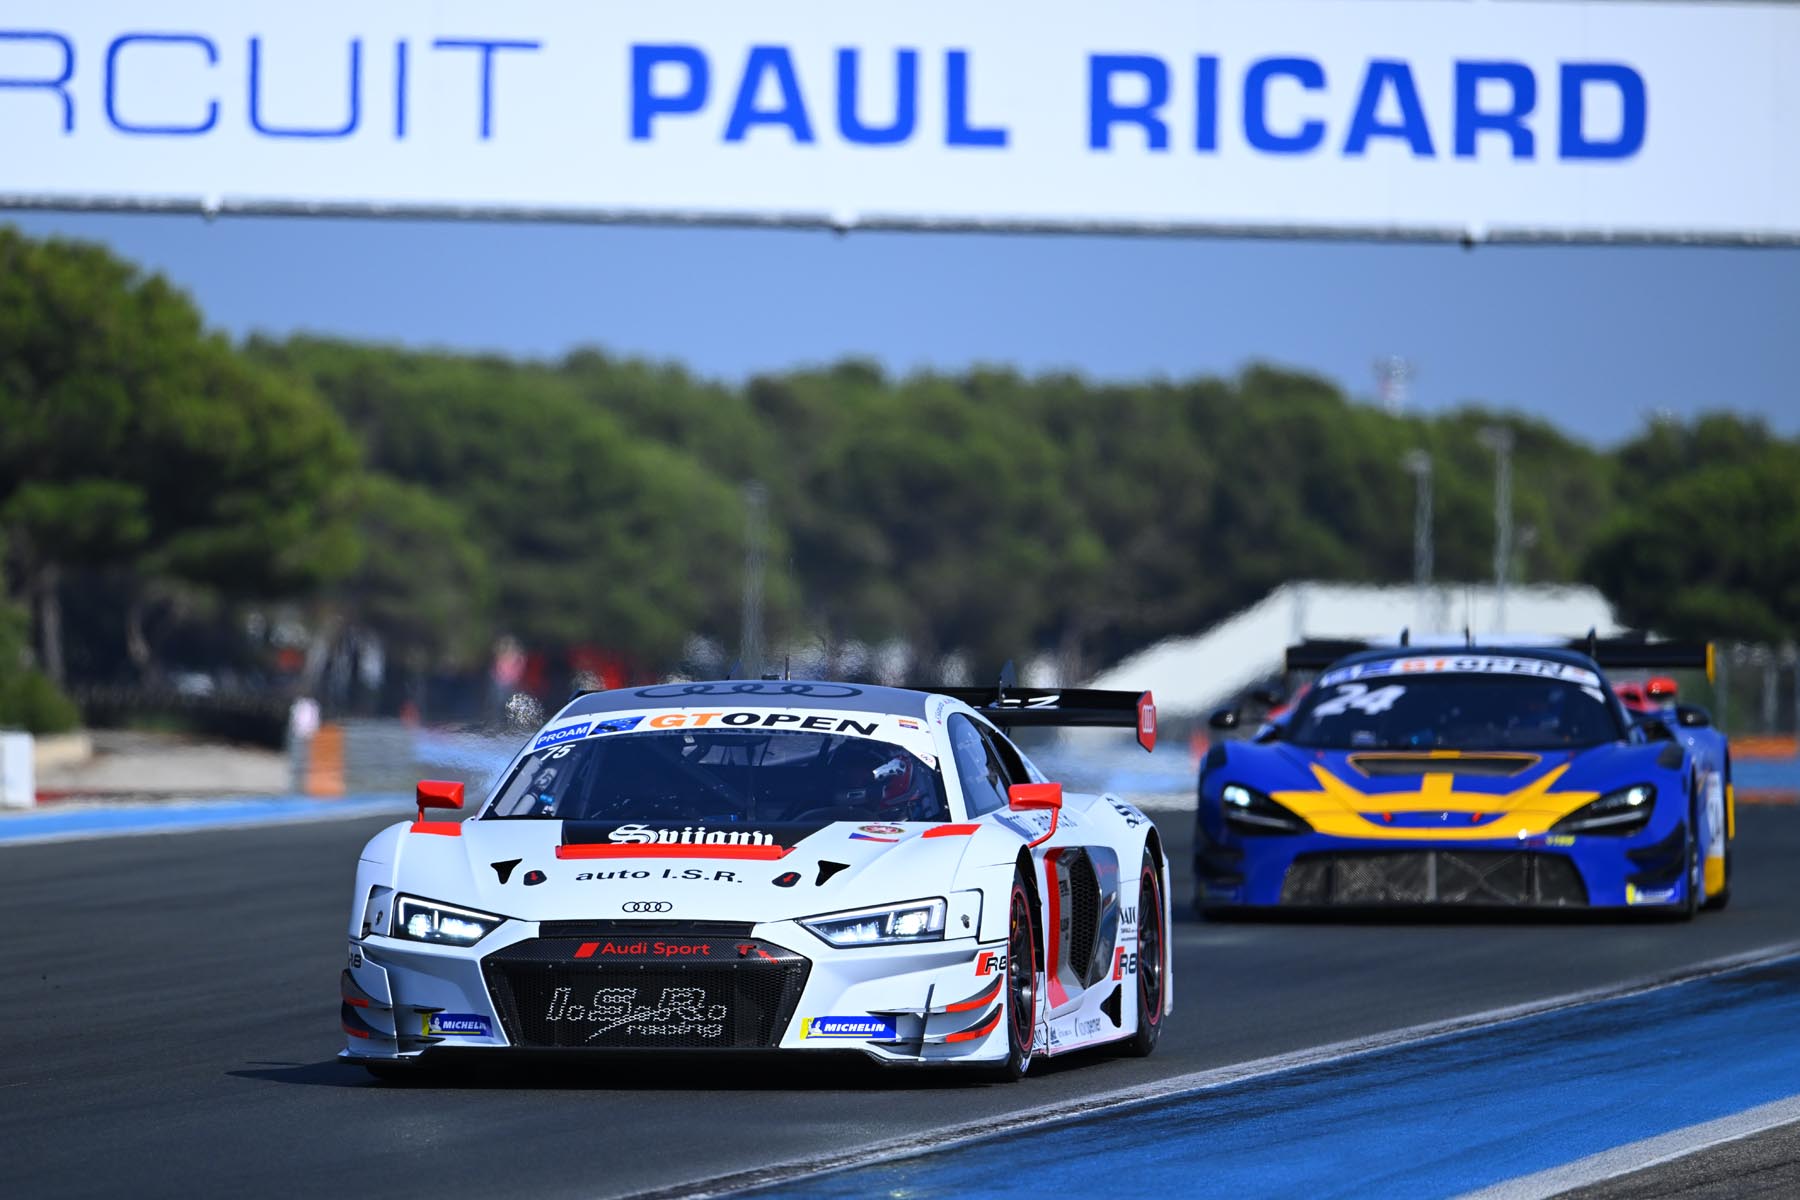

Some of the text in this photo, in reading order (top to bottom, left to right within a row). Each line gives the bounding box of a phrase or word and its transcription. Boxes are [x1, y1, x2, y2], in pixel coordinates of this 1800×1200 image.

[628, 44, 1012, 150] PAUL
[1085, 53, 1648, 163] RICARD
[1312, 684, 1407, 717] 24
[537, 726, 587, 745] PROAM
[540, 744, 577, 761] 75
[575, 869, 744, 884] auto I.S.R.
[601, 942, 711, 957] Audi Sport
[985, 956, 1007, 972] R8
[1118, 953, 1137, 975] R8
[823, 1023, 886, 1032] MICHELIN
